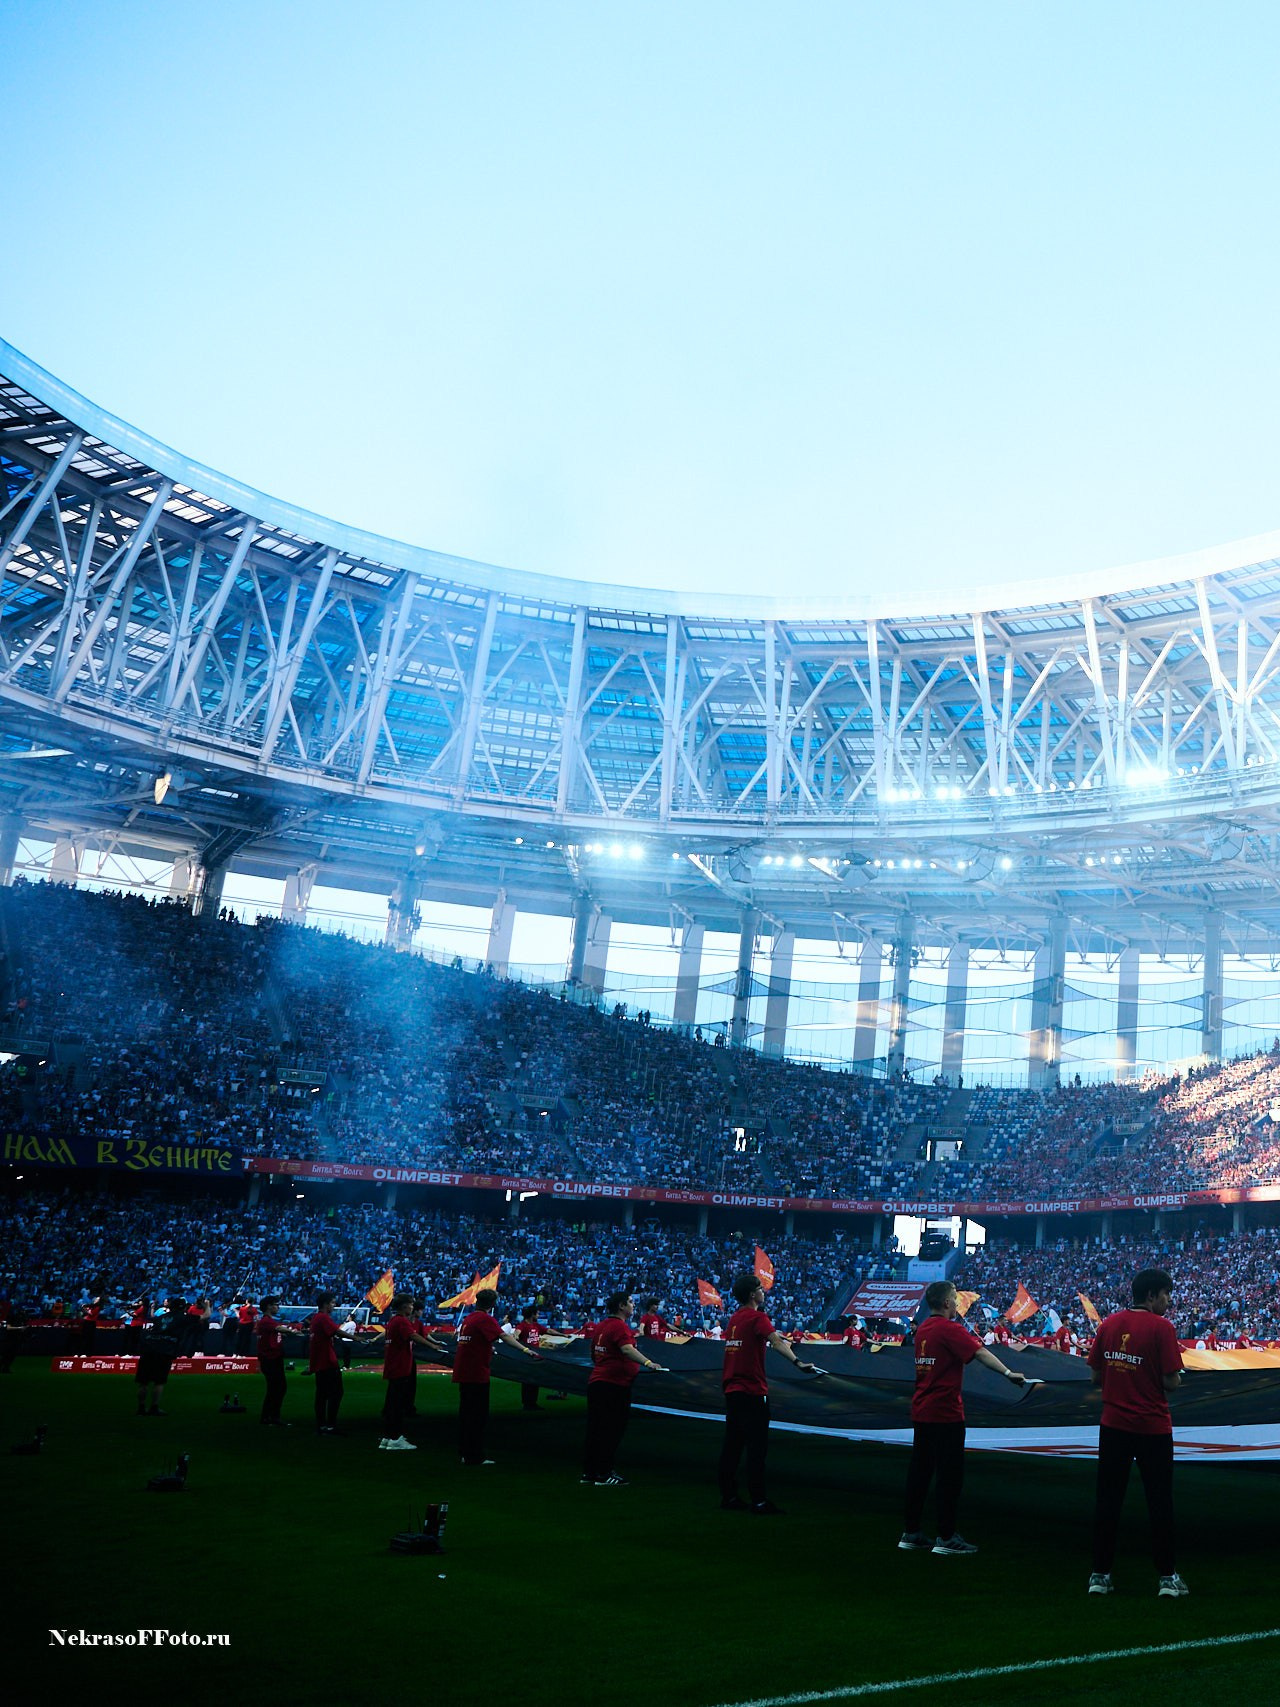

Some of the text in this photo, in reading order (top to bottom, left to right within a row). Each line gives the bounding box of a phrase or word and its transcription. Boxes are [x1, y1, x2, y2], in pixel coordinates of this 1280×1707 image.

[373, 1168, 463, 1185] OLIMPBET
[553, 1182, 632, 1197] OLIMPBET
[712, 1194, 785, 1208] OLIMPBET
[1025, 1201, 1080, 1213] OLIMPBET
[1134, 1194, 1188, 1207] OLIMPBET
[882, 1202, 955, 1213] OLIMPBET
